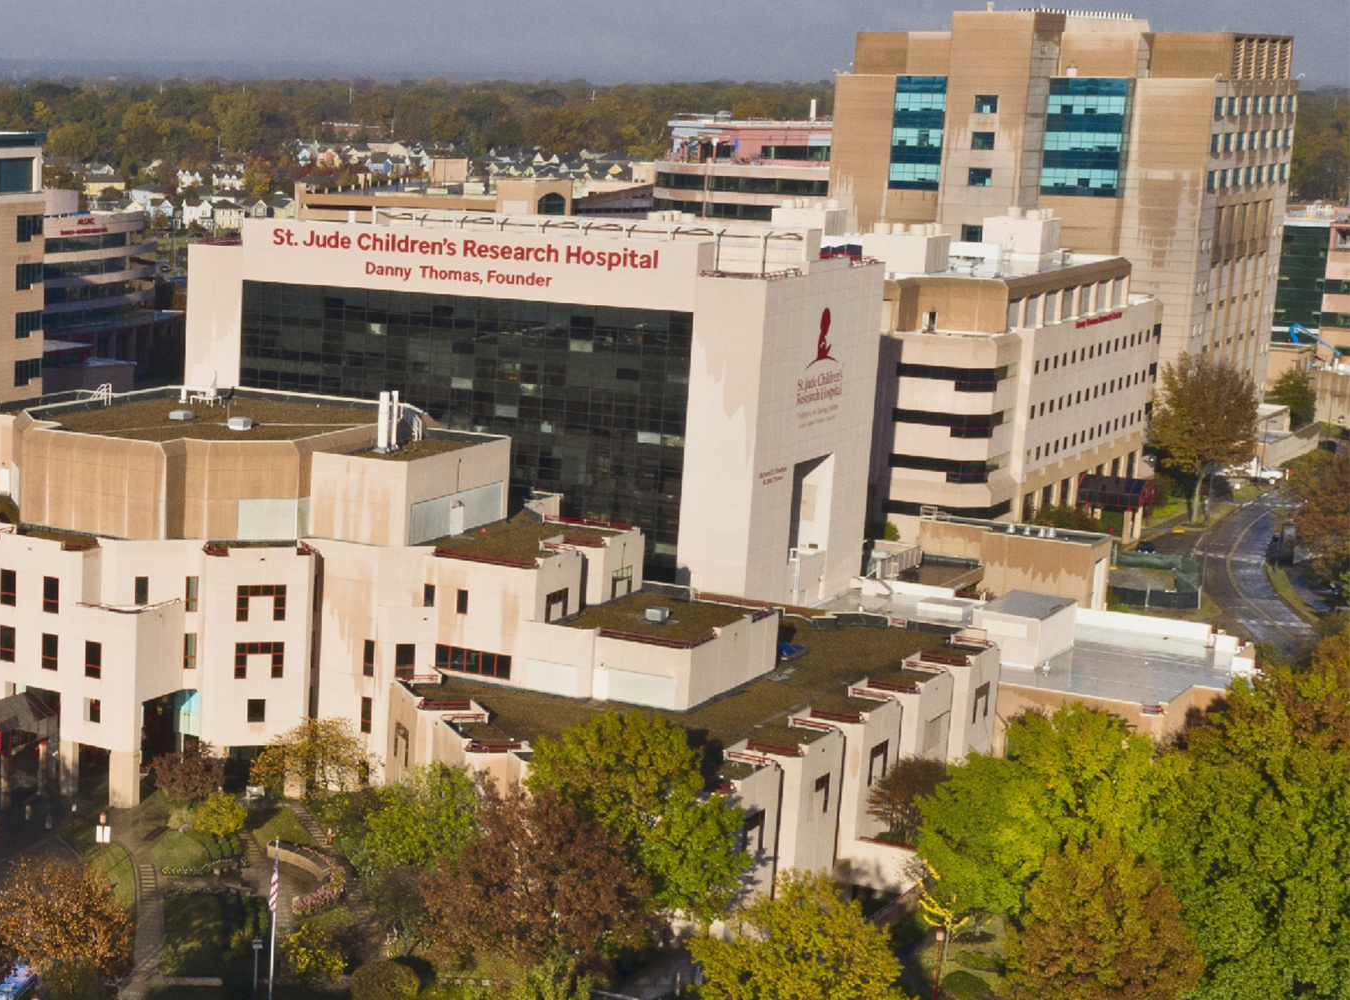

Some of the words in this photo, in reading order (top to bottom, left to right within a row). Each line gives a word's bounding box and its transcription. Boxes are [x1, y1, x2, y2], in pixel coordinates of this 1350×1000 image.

[272, 228, 299, 247] St.
[302, 230, 351, 249] Jude
[357, 233, 457, 257] Children's
[462, 239, 559, 263] Research
[565, 244, 659, 271] Hospital
[365, 261, 412, 281] Danny
[419, 265, 483, 285] Thomas,
[486, 269, 552, 287] Founder
